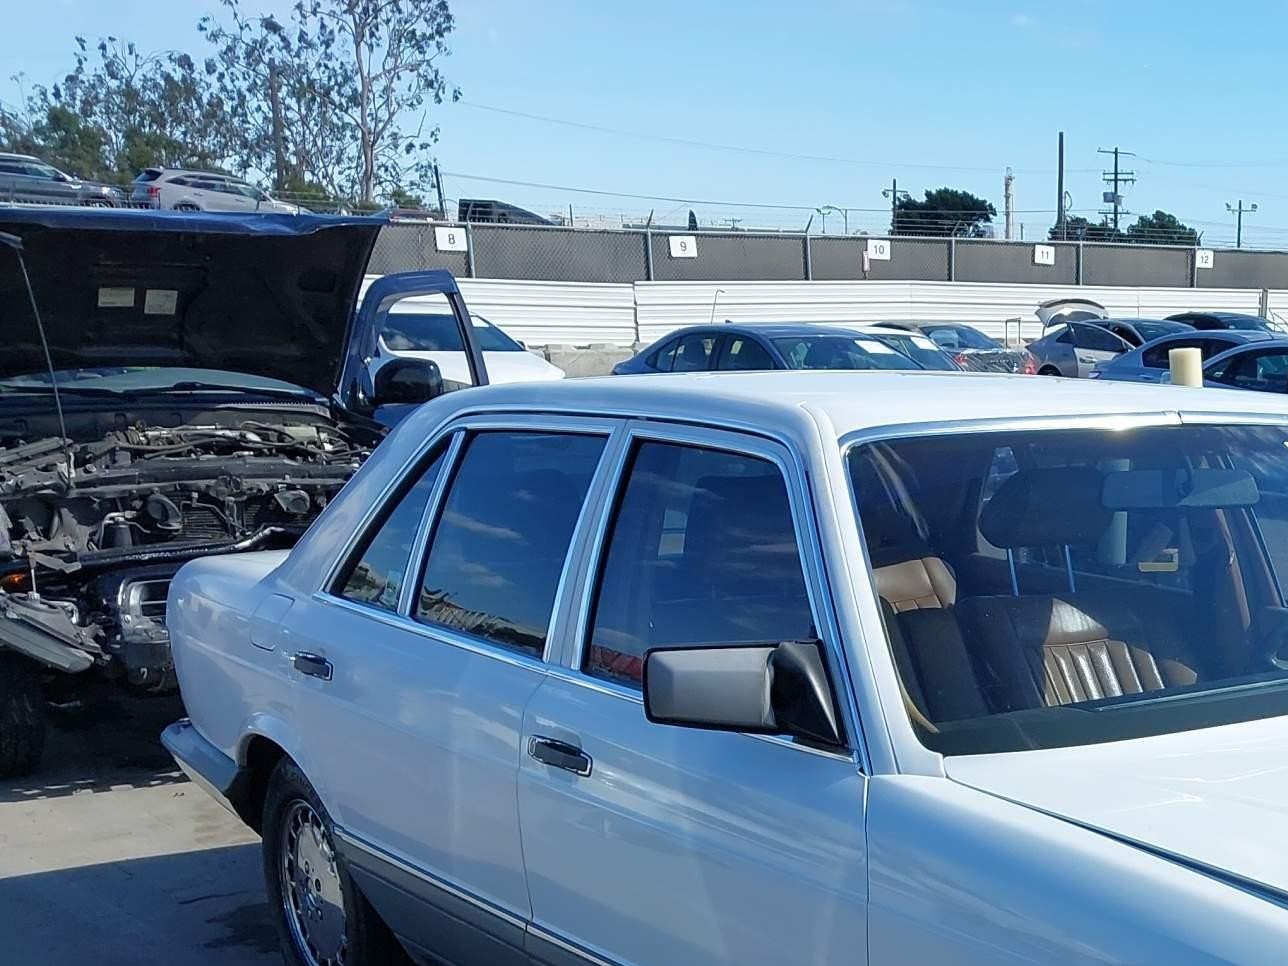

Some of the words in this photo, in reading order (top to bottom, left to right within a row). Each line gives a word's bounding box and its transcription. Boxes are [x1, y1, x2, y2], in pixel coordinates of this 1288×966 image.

[448, 233, 455, 245] 8
[680, 241, 687, 251] 9
[873, 244, 885, 255] 10
[1040, 250, 1049, 260] 11
[1200, 254, 1208, 264] 12
